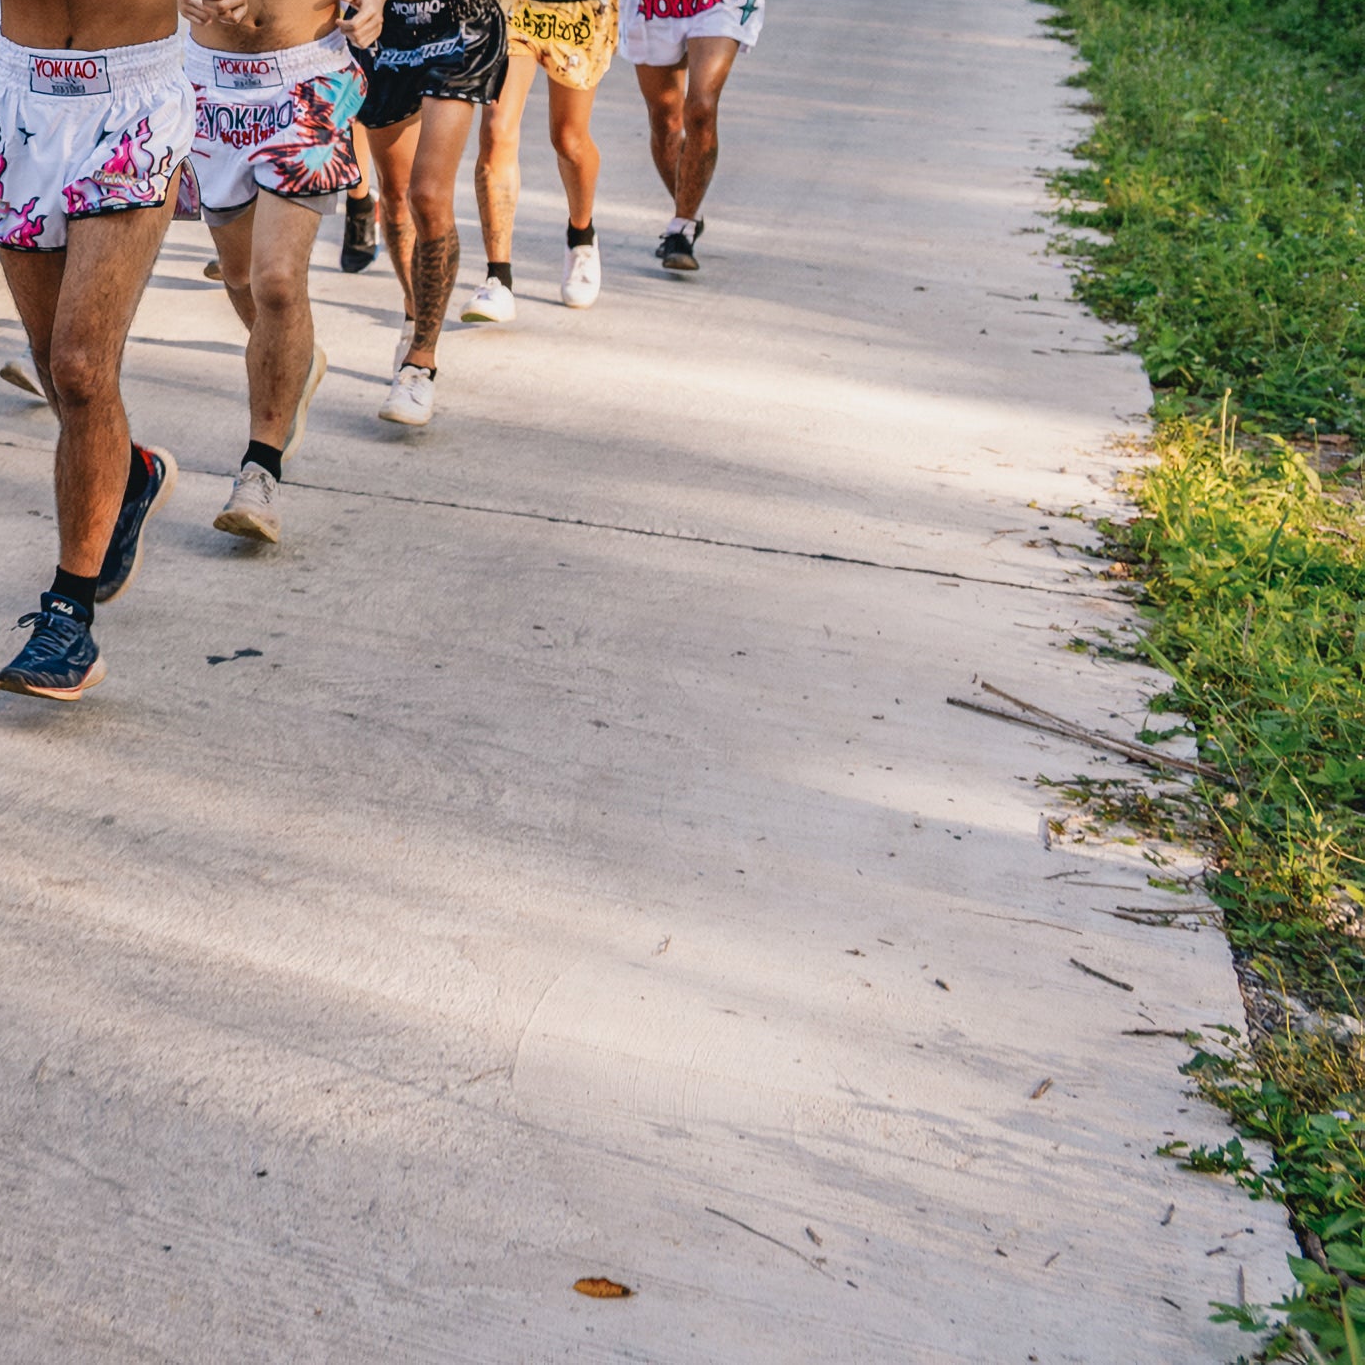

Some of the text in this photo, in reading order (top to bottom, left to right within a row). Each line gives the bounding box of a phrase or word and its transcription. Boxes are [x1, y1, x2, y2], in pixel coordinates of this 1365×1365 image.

[393, 0, 441, 14] YOKKAO
[35, 59, 97, 79] YOKKAO
[219, 59, 270, 74] YOKKAO
[204, 100, 293, 139] YOKKAO
[51, 599, 74, 615] FILA
